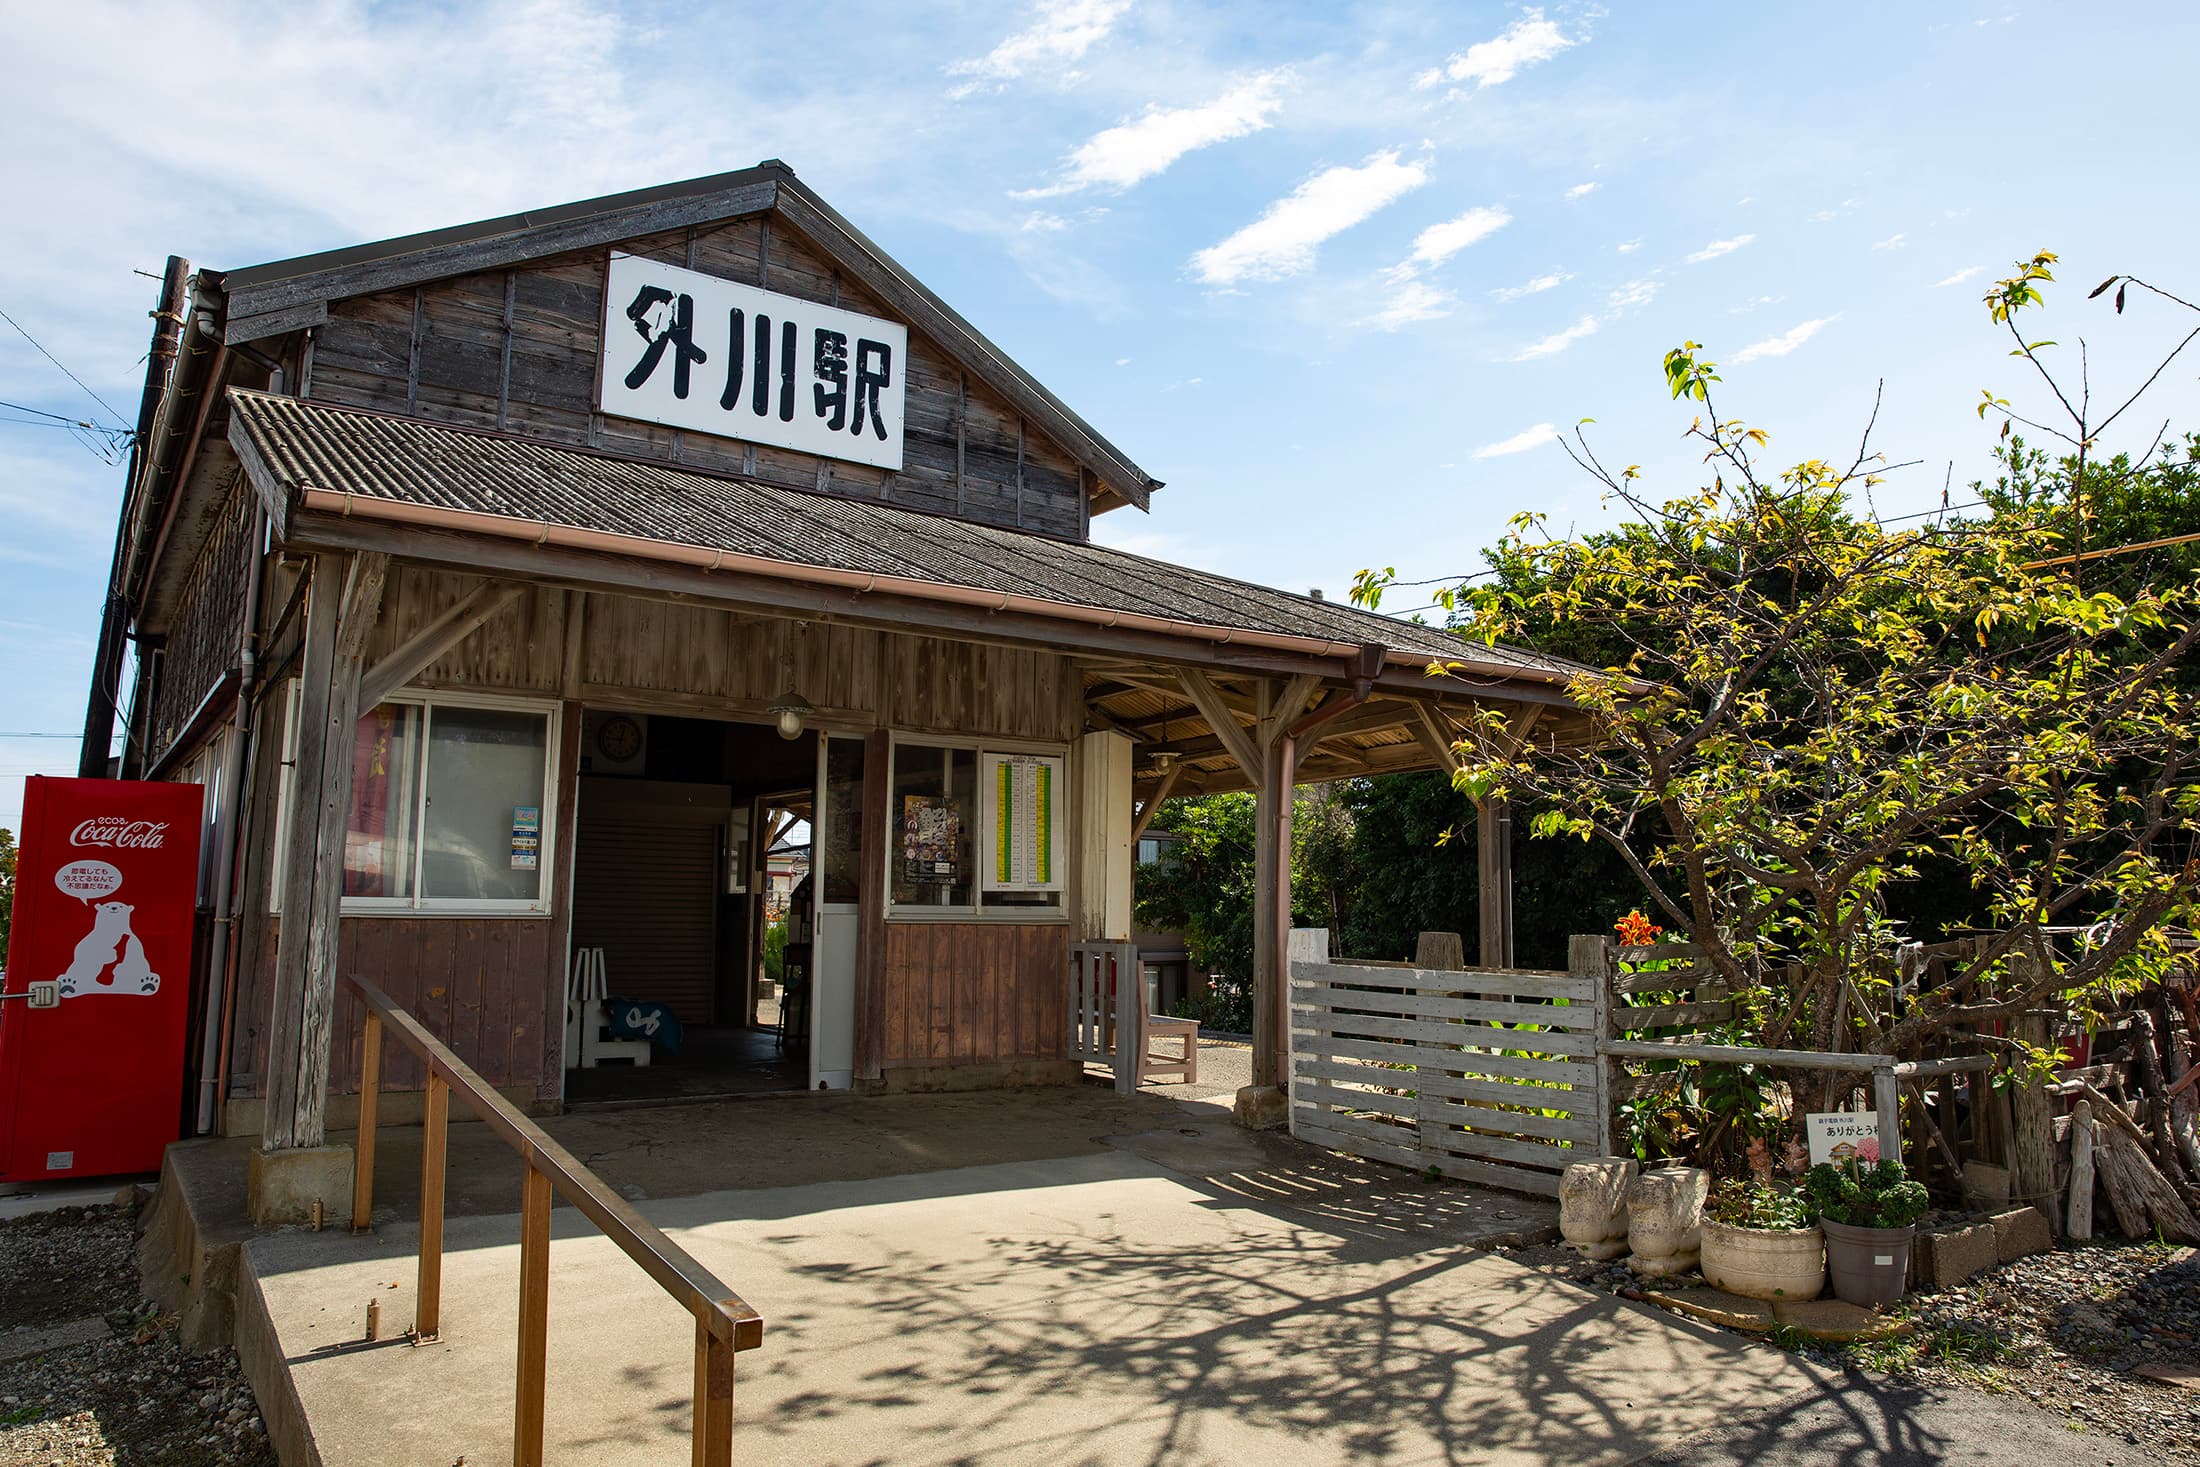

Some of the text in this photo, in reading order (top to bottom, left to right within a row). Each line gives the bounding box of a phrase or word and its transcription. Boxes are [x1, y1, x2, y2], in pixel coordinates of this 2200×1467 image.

[624, 284, 892, 441] 外川駅
[69, 819, 170, 849] Coca-Cola
[71, 867, 109, 875] 節電しても
